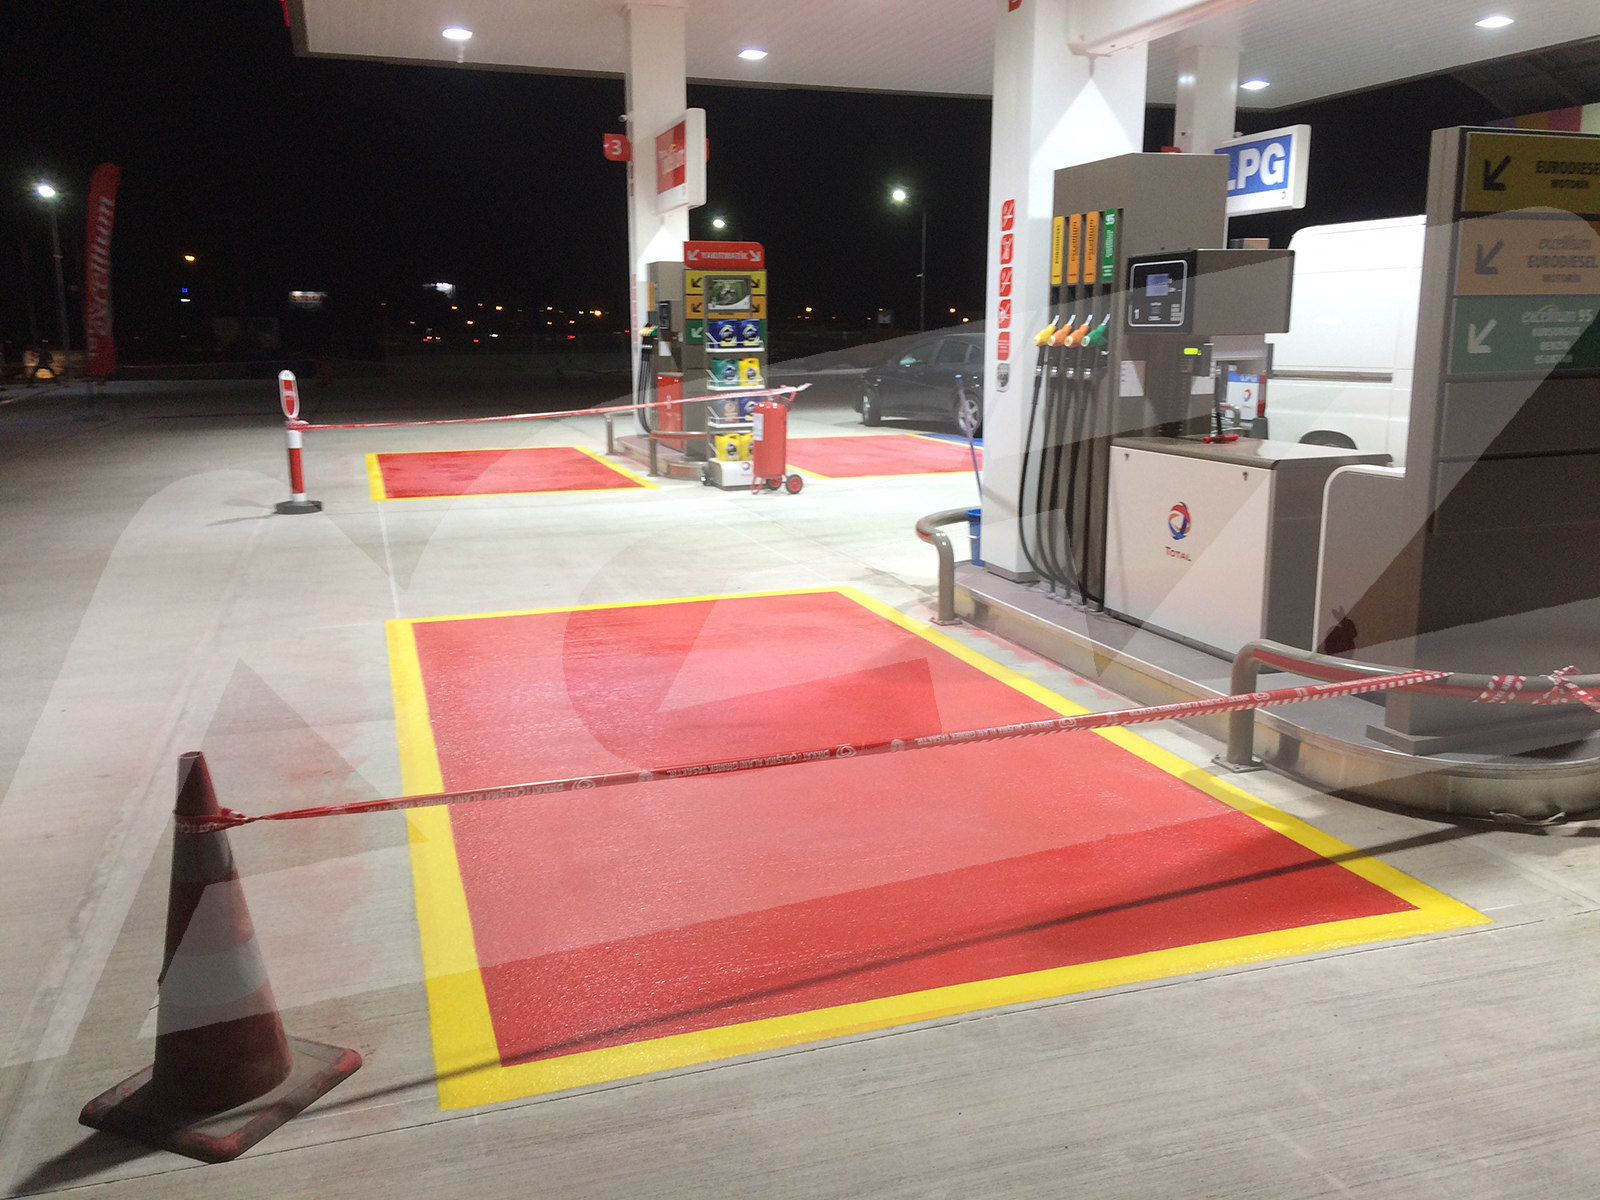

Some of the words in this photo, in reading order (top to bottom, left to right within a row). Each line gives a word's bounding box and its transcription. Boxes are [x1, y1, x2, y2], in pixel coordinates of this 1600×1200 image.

[611, 139, 622, 155] 3
[1165, 546, 1192, 562] TOTAL
[739, 756, 764, 769] ALANI
